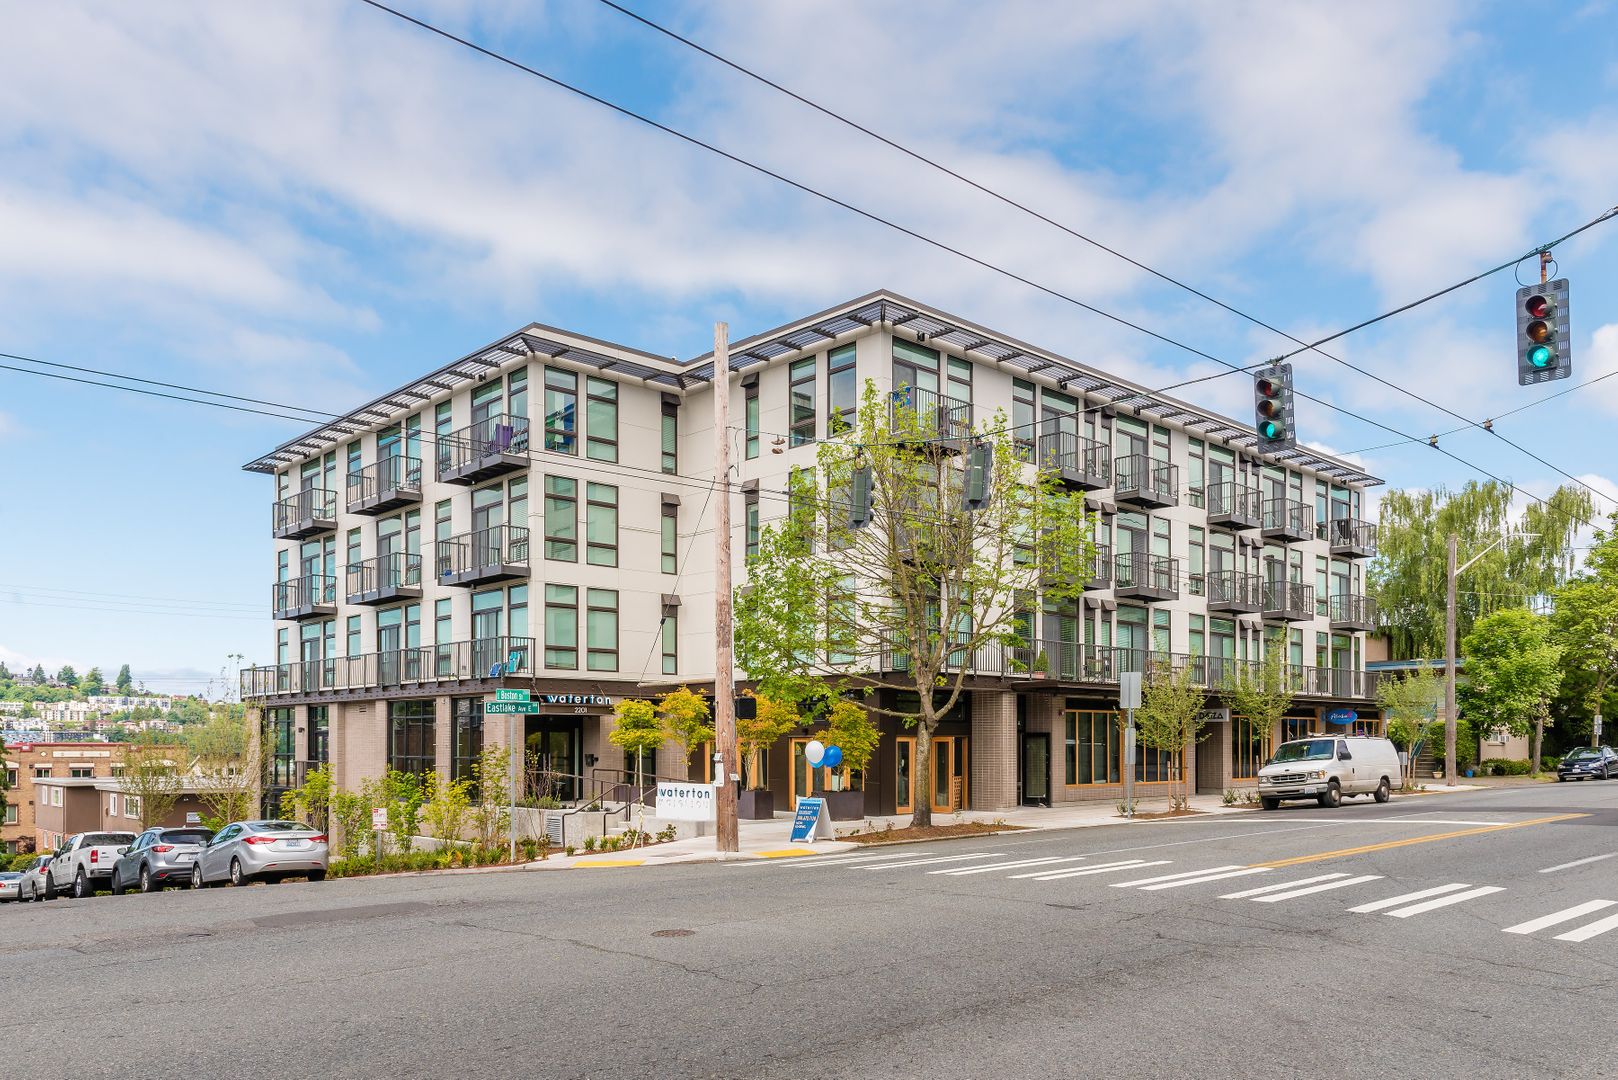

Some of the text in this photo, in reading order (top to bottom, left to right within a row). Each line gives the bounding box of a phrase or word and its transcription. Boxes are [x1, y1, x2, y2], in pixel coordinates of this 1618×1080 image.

[500, 690, 519, 700] Boston
[547, 694, 611, 704] waterton
[487, 703, 516, 713] Eastlake
[658, 787, 710, 799] waterton
